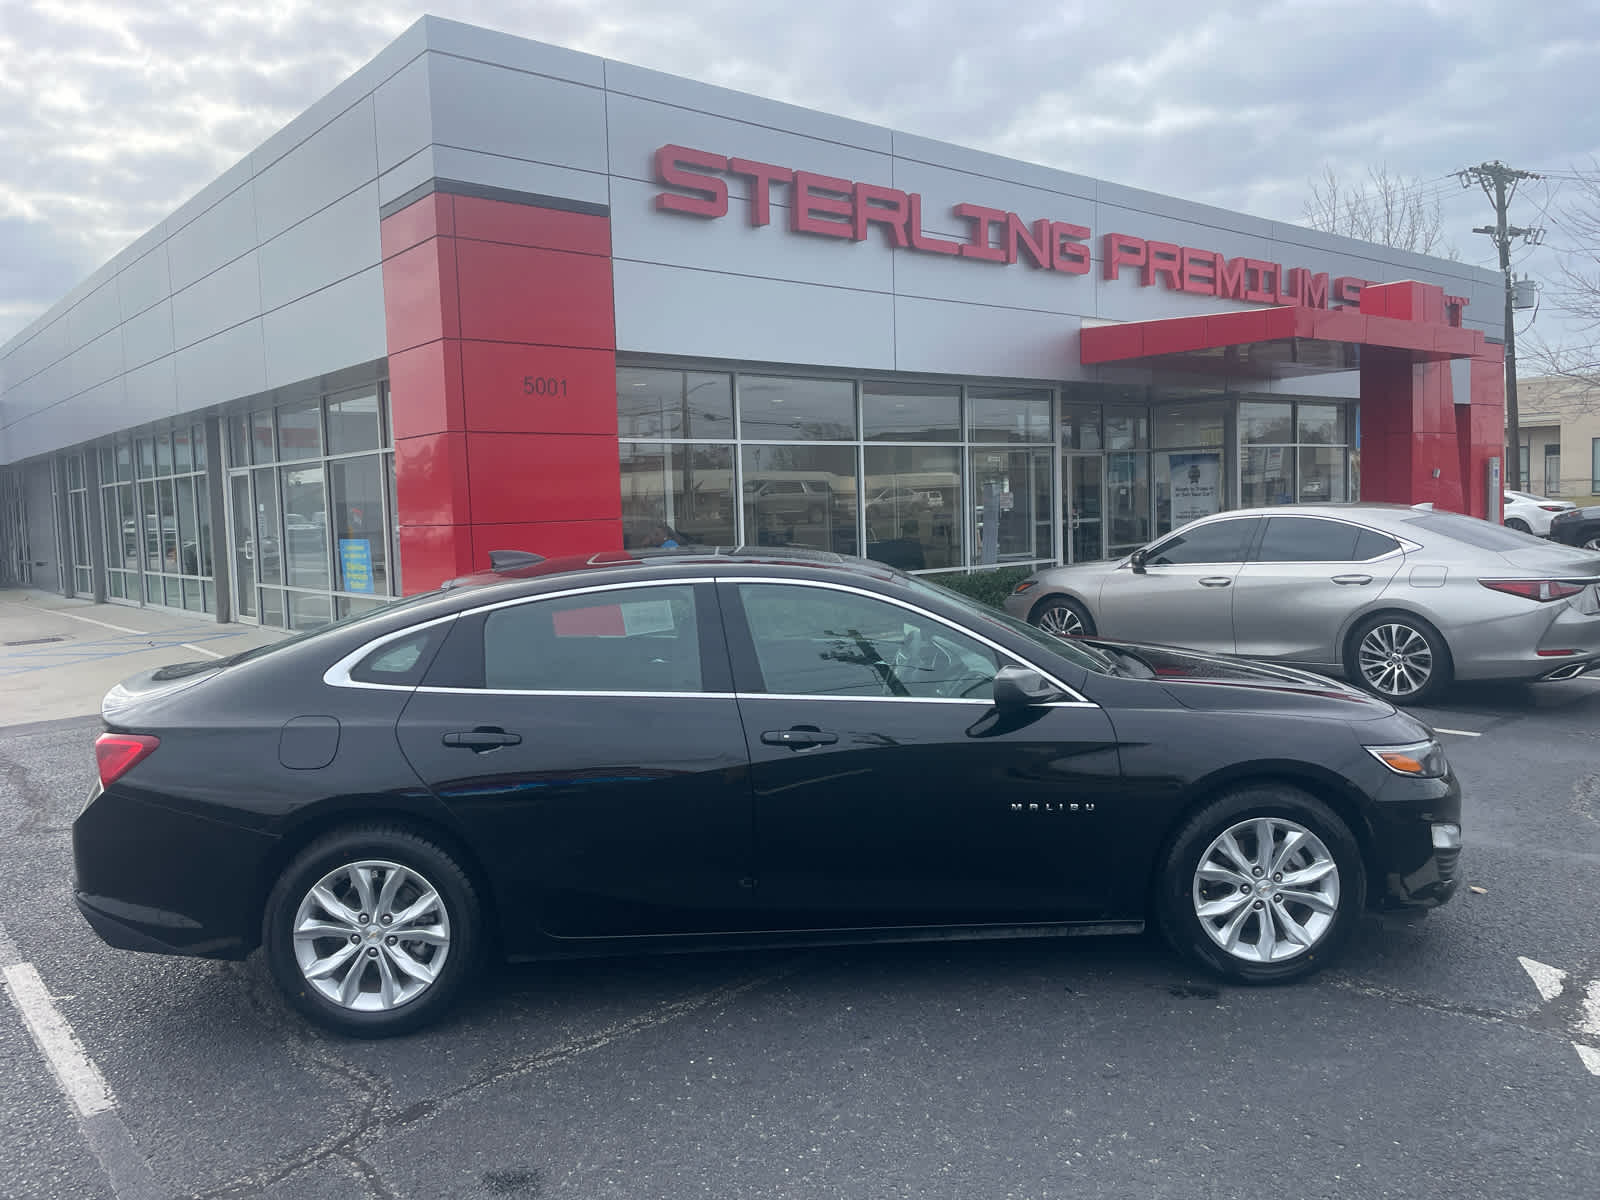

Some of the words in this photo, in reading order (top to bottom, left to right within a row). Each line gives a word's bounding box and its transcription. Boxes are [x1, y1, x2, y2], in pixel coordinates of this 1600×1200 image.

[655, 143, 1091, 276] STERLING
[1103, 233, 1329, 310] PREMIUM
[523, 376, 567, 396] 5001
[1011, 803, 1095, 811] MALIBU
